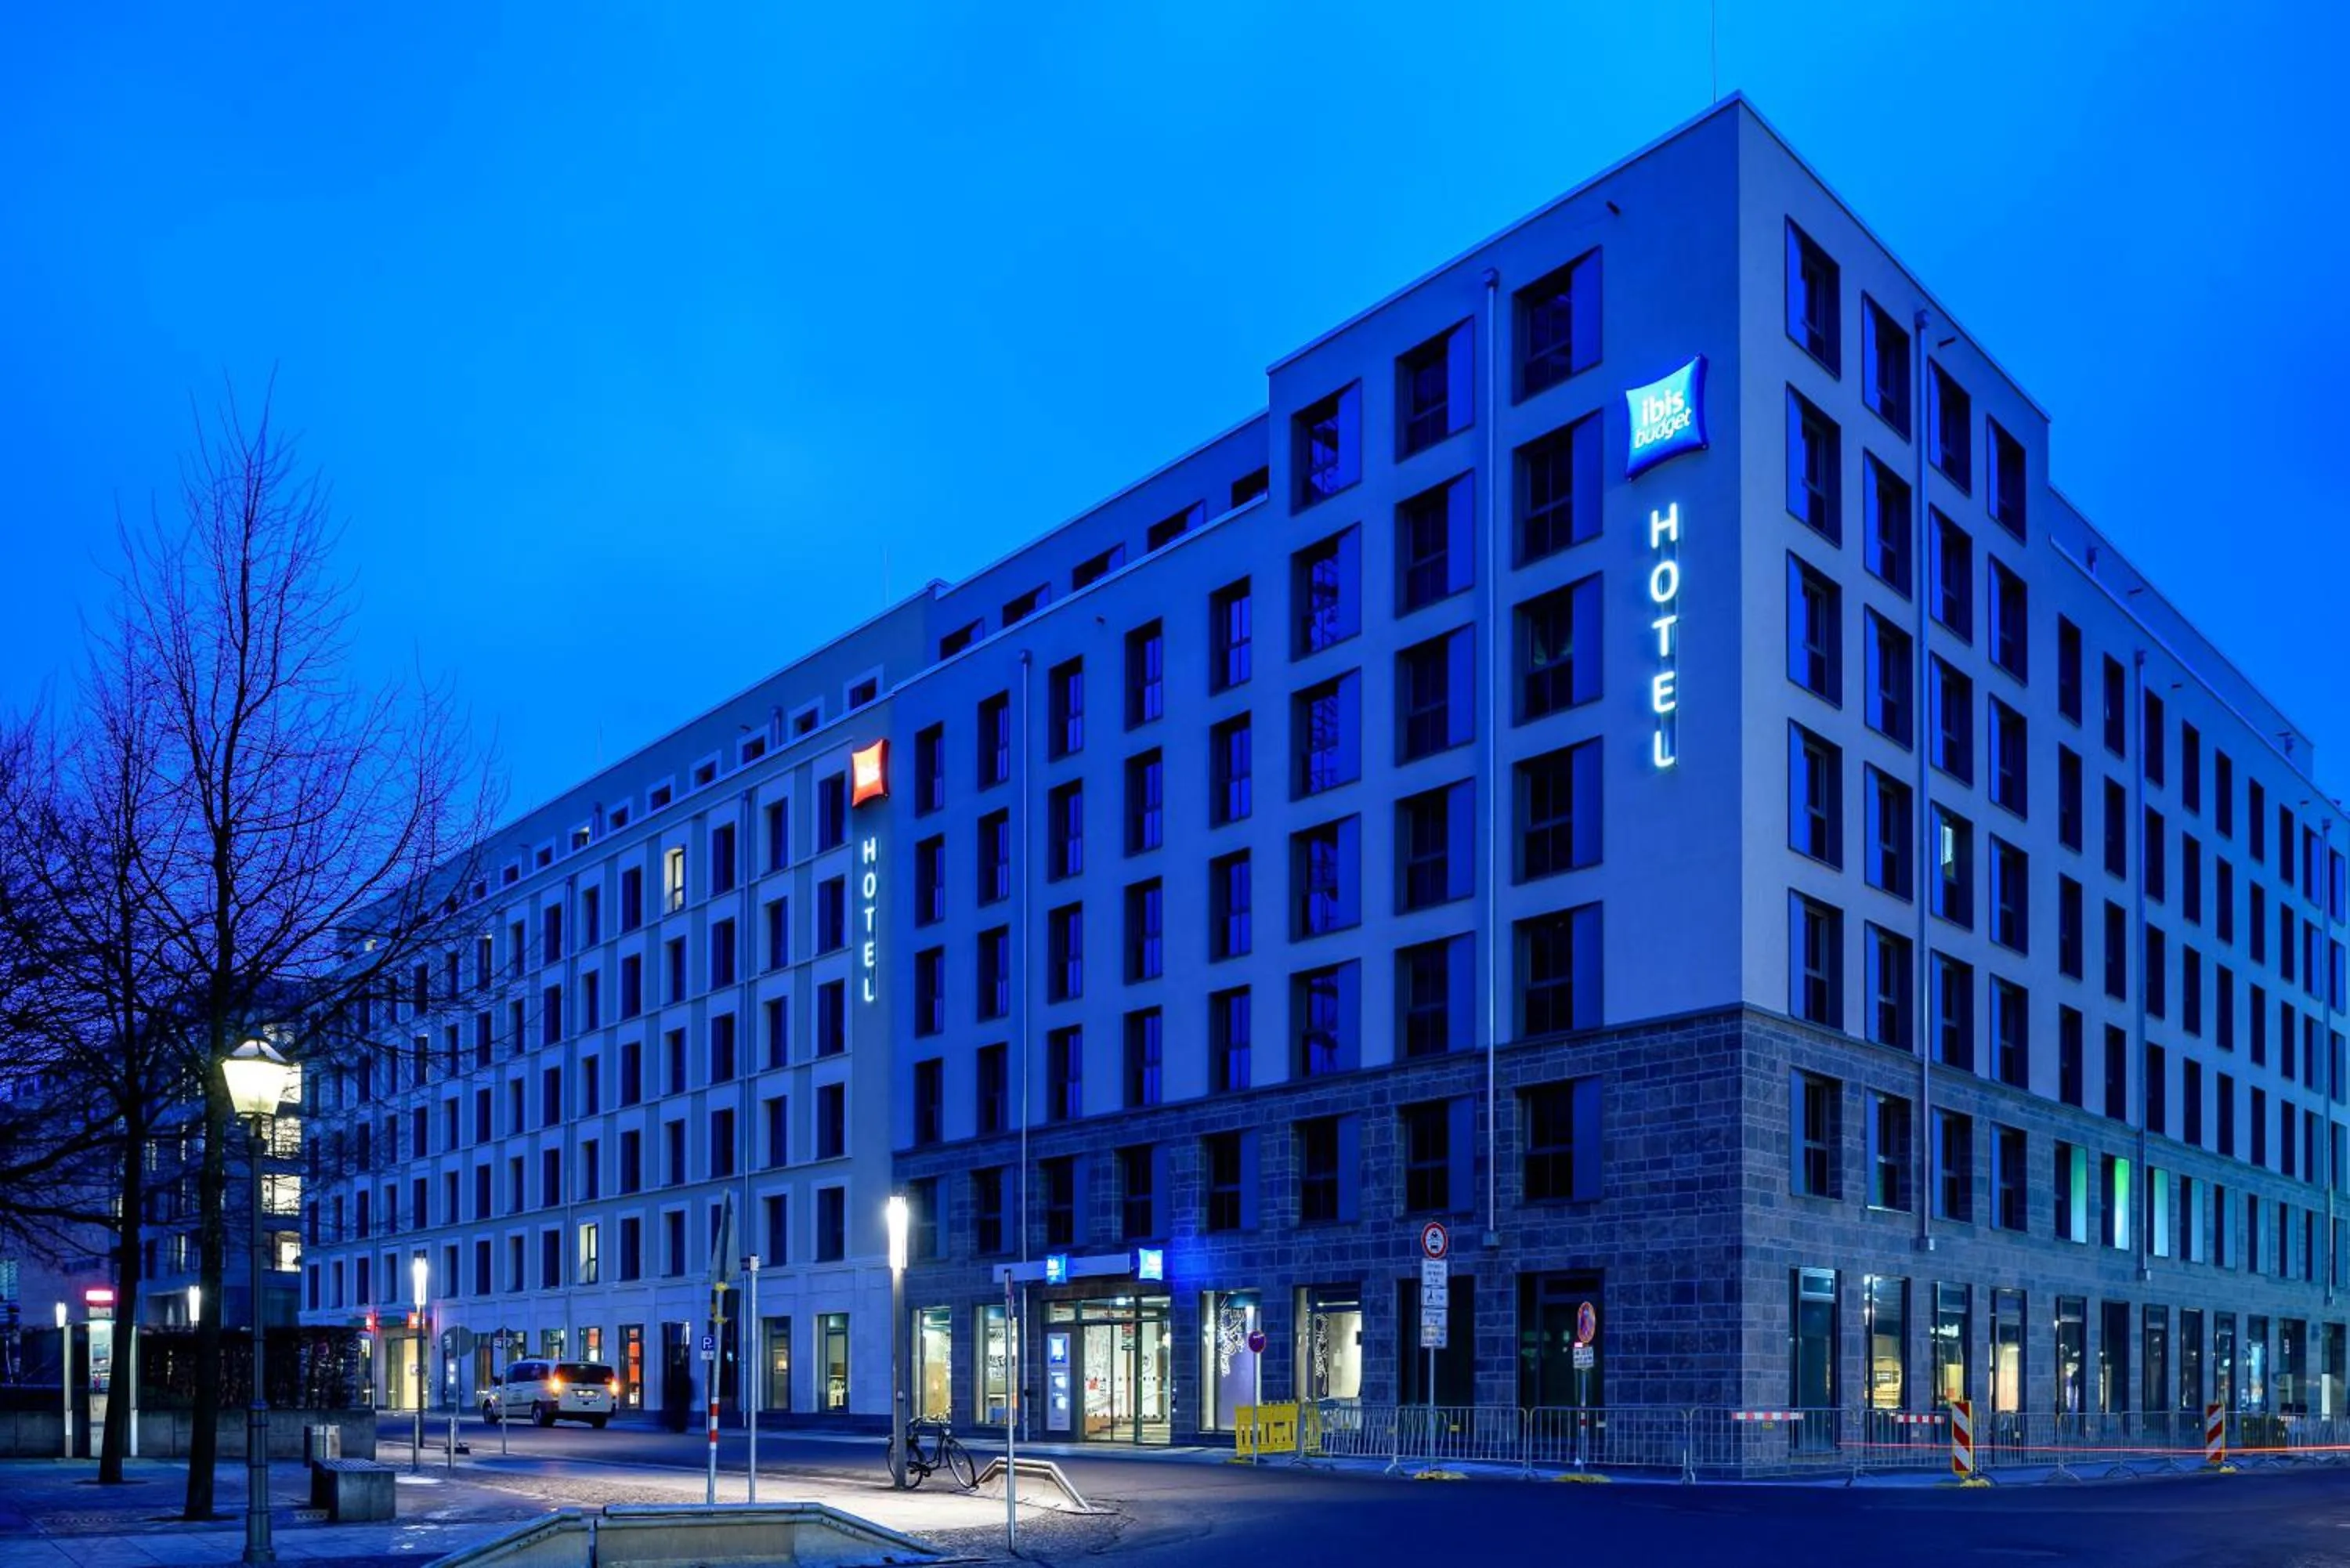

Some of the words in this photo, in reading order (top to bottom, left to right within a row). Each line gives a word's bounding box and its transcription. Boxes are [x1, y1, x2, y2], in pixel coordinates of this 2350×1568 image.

[1634, 407, 1692, 449] budget
[1641, 388, 1685, 428] ibis
[1649, 502, 1679, 768] HOTEL
[862, 837, 877, 1003] HOTEL
